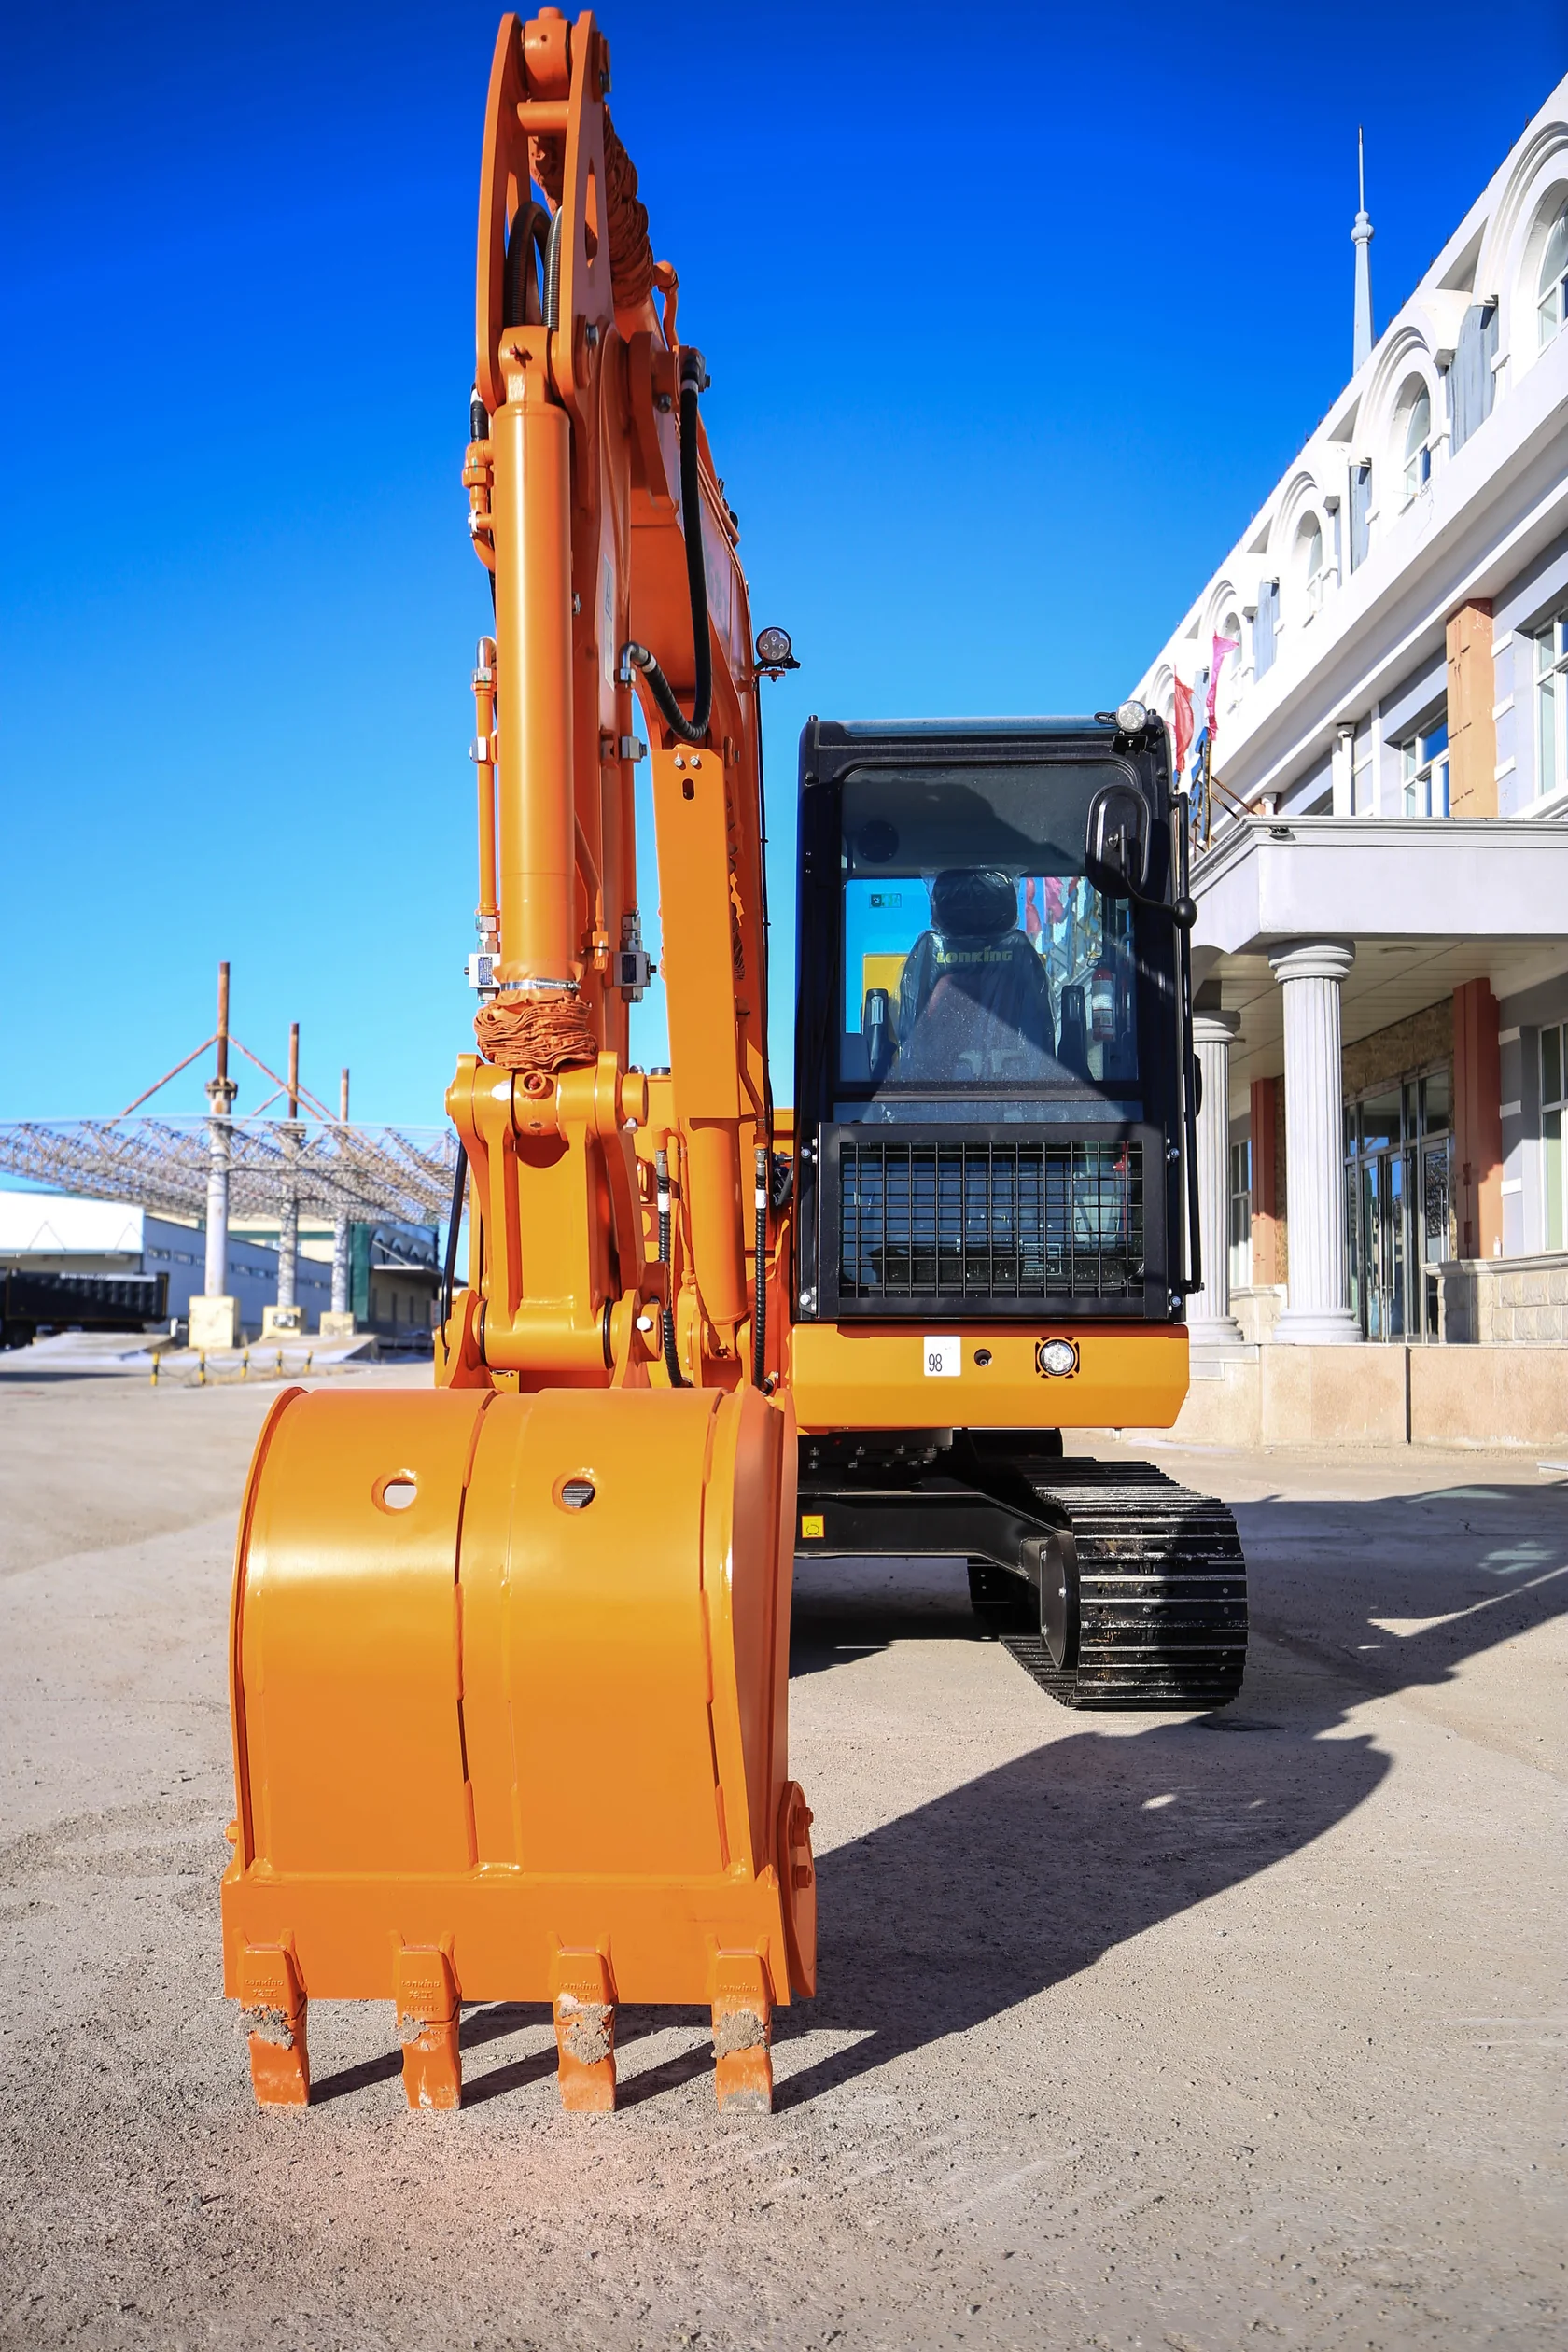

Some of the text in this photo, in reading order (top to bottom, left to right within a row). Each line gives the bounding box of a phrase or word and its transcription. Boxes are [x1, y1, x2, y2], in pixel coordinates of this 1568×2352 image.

[928, 1353, 943, 1372] 98
[252, 1988, 278, 1998] 龙工
[408, 1990, 434, 2000] 龙工
